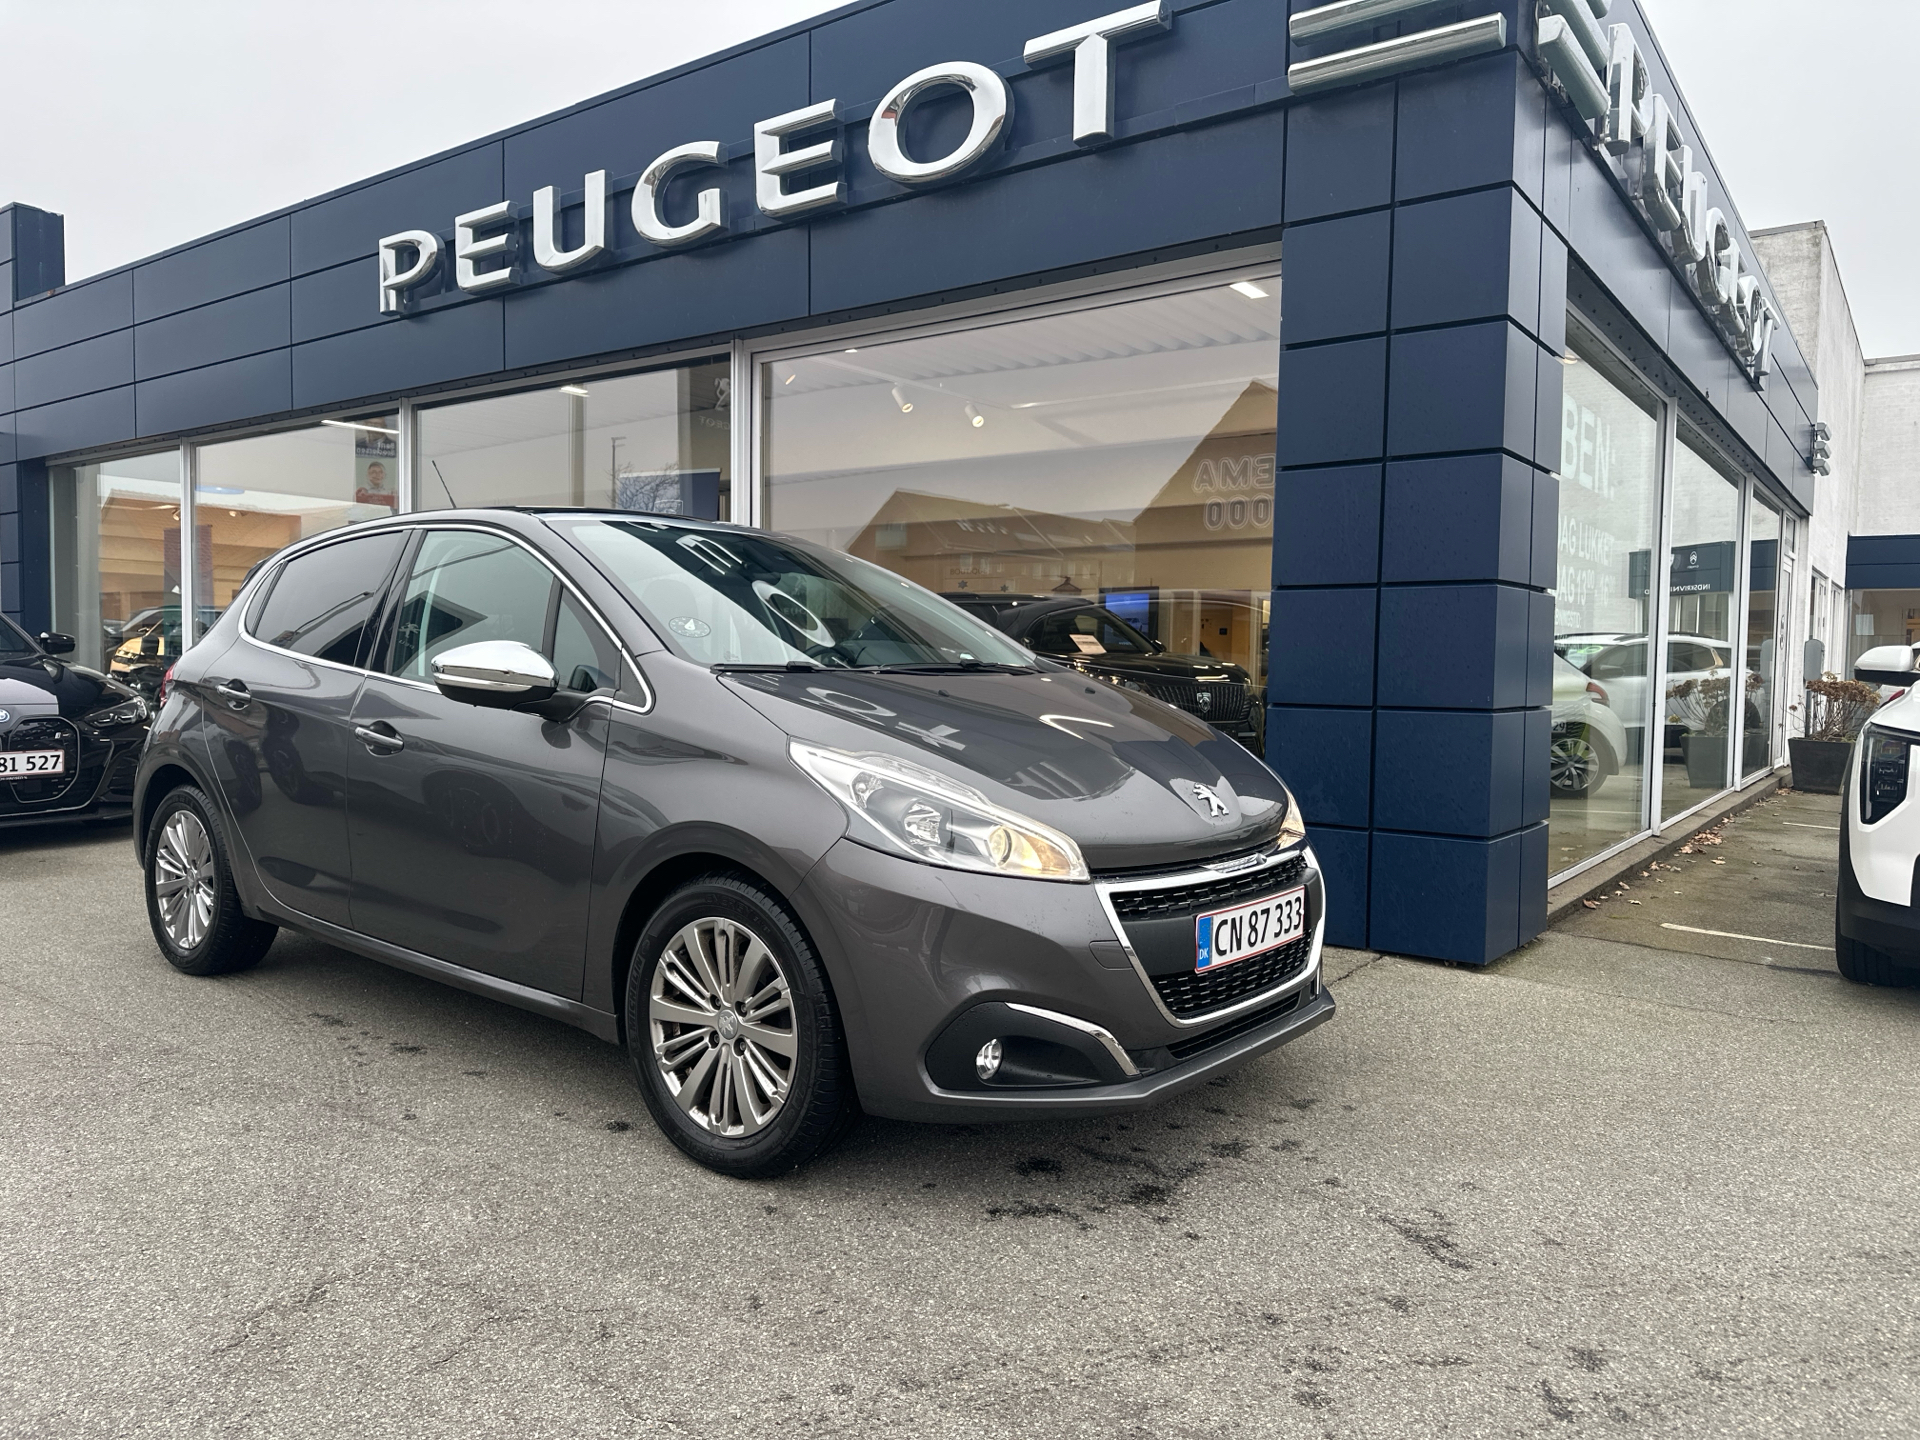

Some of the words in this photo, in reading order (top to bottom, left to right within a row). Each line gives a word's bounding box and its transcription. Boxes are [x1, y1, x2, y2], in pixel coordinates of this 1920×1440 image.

[379, 0, 1172, 315] PEUGEOT
[1561, 392, 1616, 501] BEN:
[1558, 515, 1577, 556] AG
[1578, 521, 1615, 568] LUKKET
[1557, 565, 1575, 604] AG
[1552, 721, 1565, 732] 29
[0, 757, 18, 773] 81
[26, 755, 60, 771] 527
[1214, 914, 1243, 957] CN
[1247, 907, 1271, 948] 87
[1273, 896, 1302, 939] 333
[1199, 947, 1209, 960] DK
[628, 953, 645, 1032] MICHELIN
